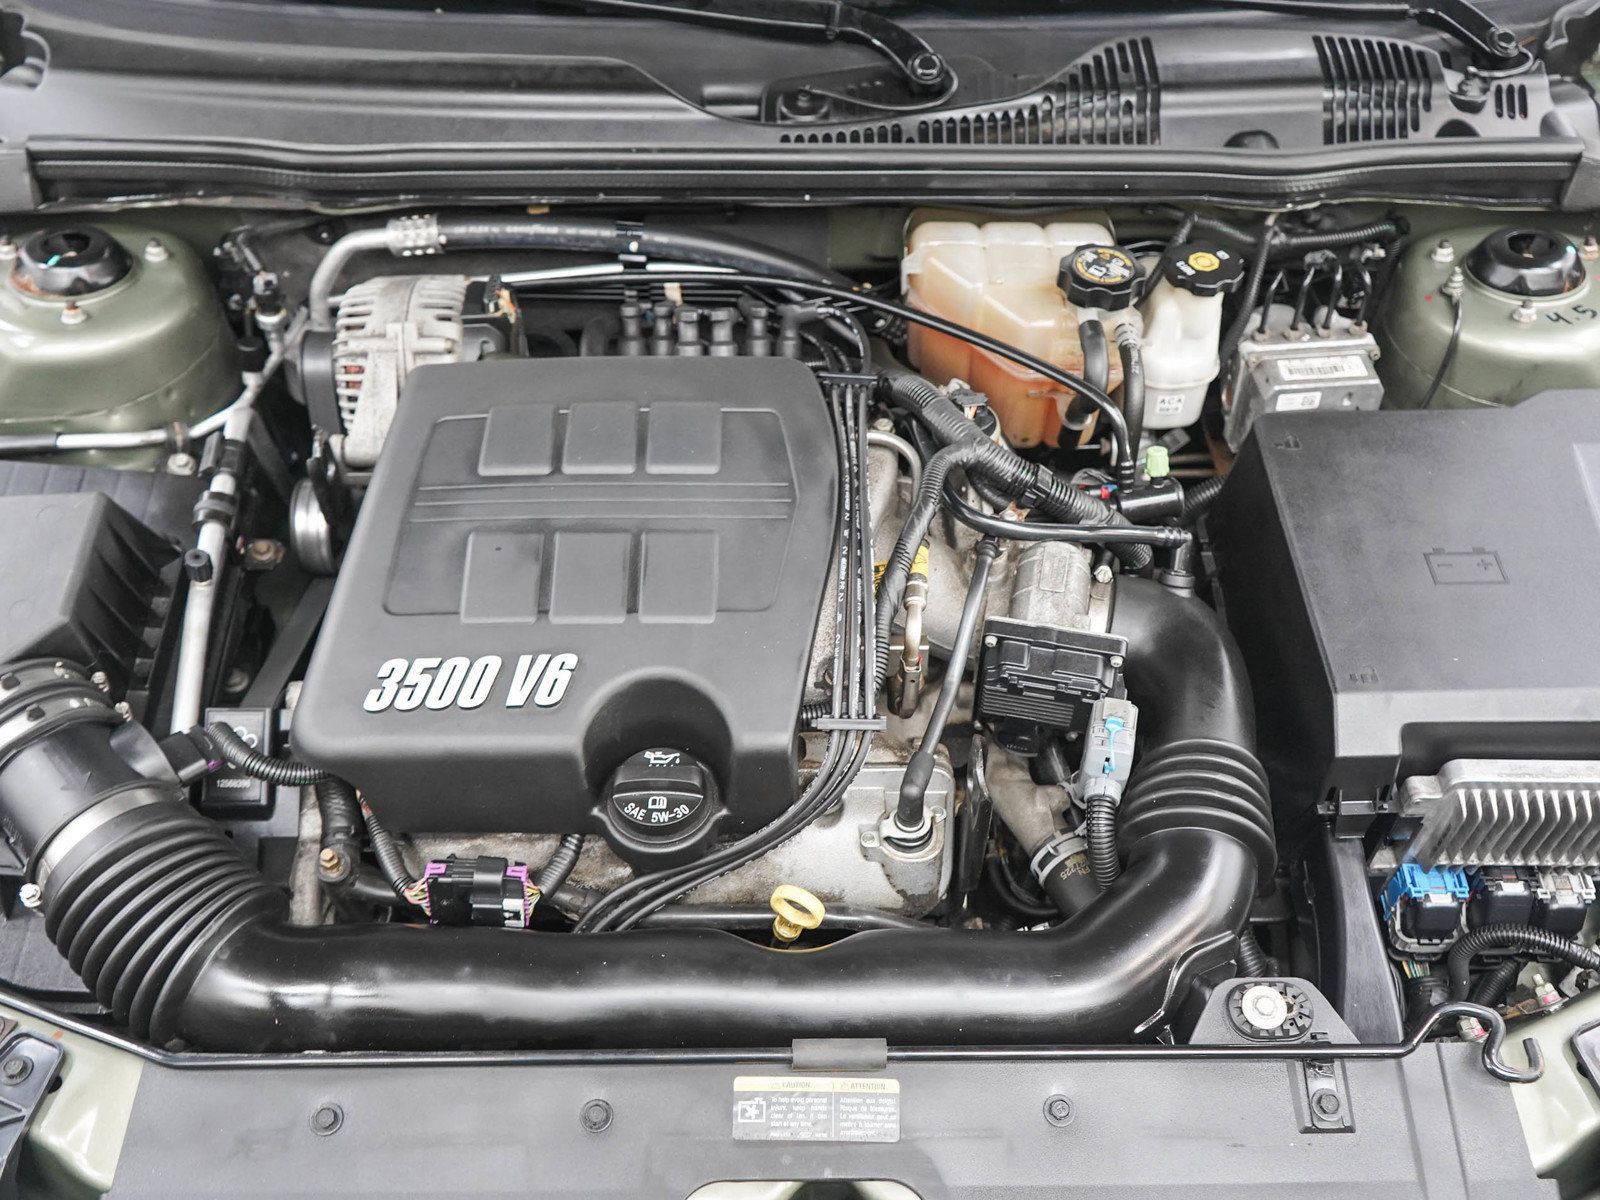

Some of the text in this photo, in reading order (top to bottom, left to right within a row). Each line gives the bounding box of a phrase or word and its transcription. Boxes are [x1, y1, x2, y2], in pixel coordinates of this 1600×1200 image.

[362, 653, 579, 712] 3500 V6
[624, 802, 690, 823] SAE 5W-30
[782, 1081, 811, 1089] CAUTION
